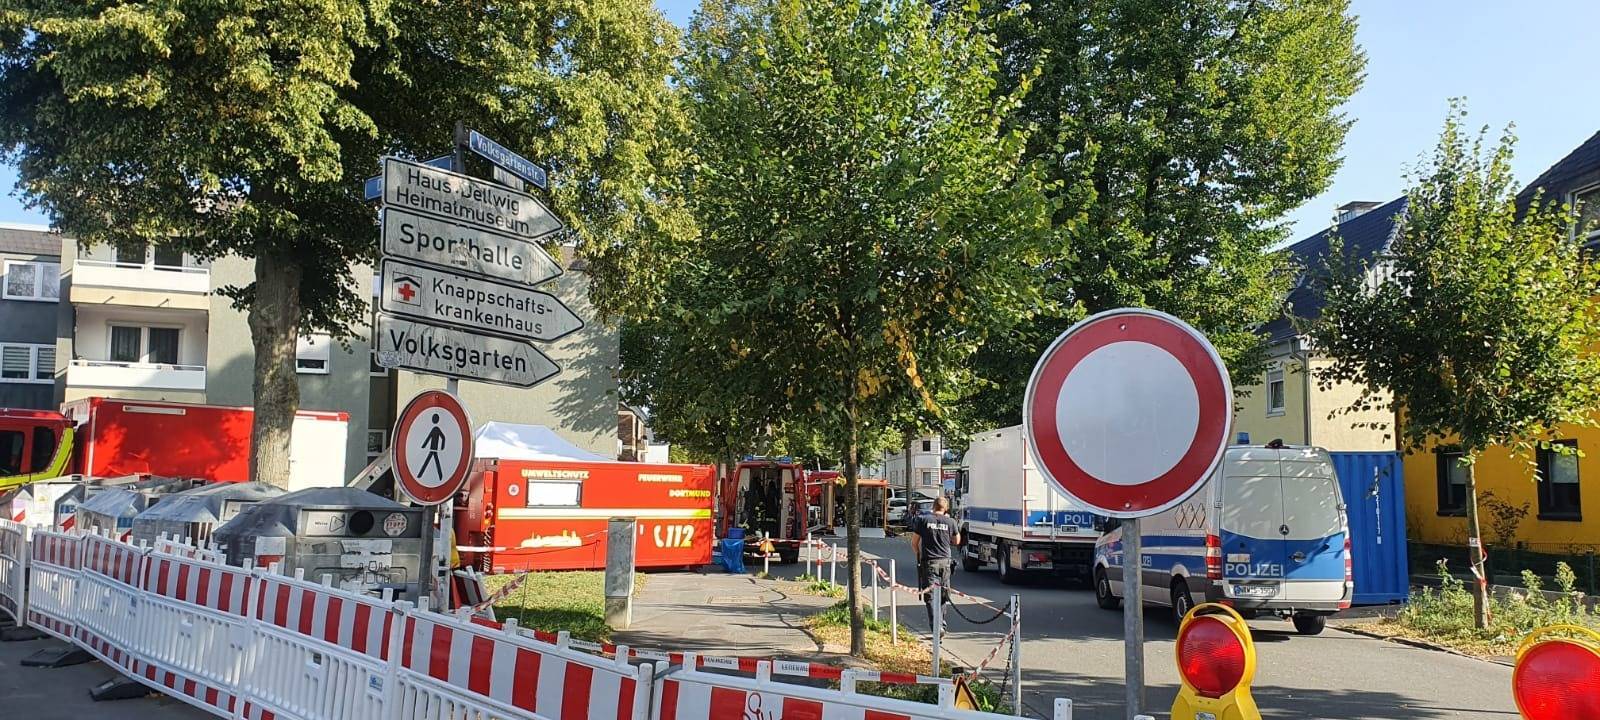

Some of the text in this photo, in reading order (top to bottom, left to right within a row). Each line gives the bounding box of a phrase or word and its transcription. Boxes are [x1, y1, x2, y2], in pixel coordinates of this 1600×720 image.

[476, 135, 540, 181] Volksgartenstr.
[408, 168, 451, 194] Haus
[460, 183, 520, 216] Dellwig
[396, 186, 529, 234] Heimatmuseum
[433, 277, 553, 315] Knappschafts-
[435, 300, 543, 335] krankenhaus
[390, 329, 526, 373] Volksgarten
[521, 469, 590, 479] UMWELTSCHUTZ
[638, 474, 684, 483] FEUERWEHR
[669, 489, 711, 498] DORTMUND
[665, 525, 695, 548] 112
[926, 522, 949, 531] POLIZEI
[1225, 563, 1284, 577] POLIZEI
